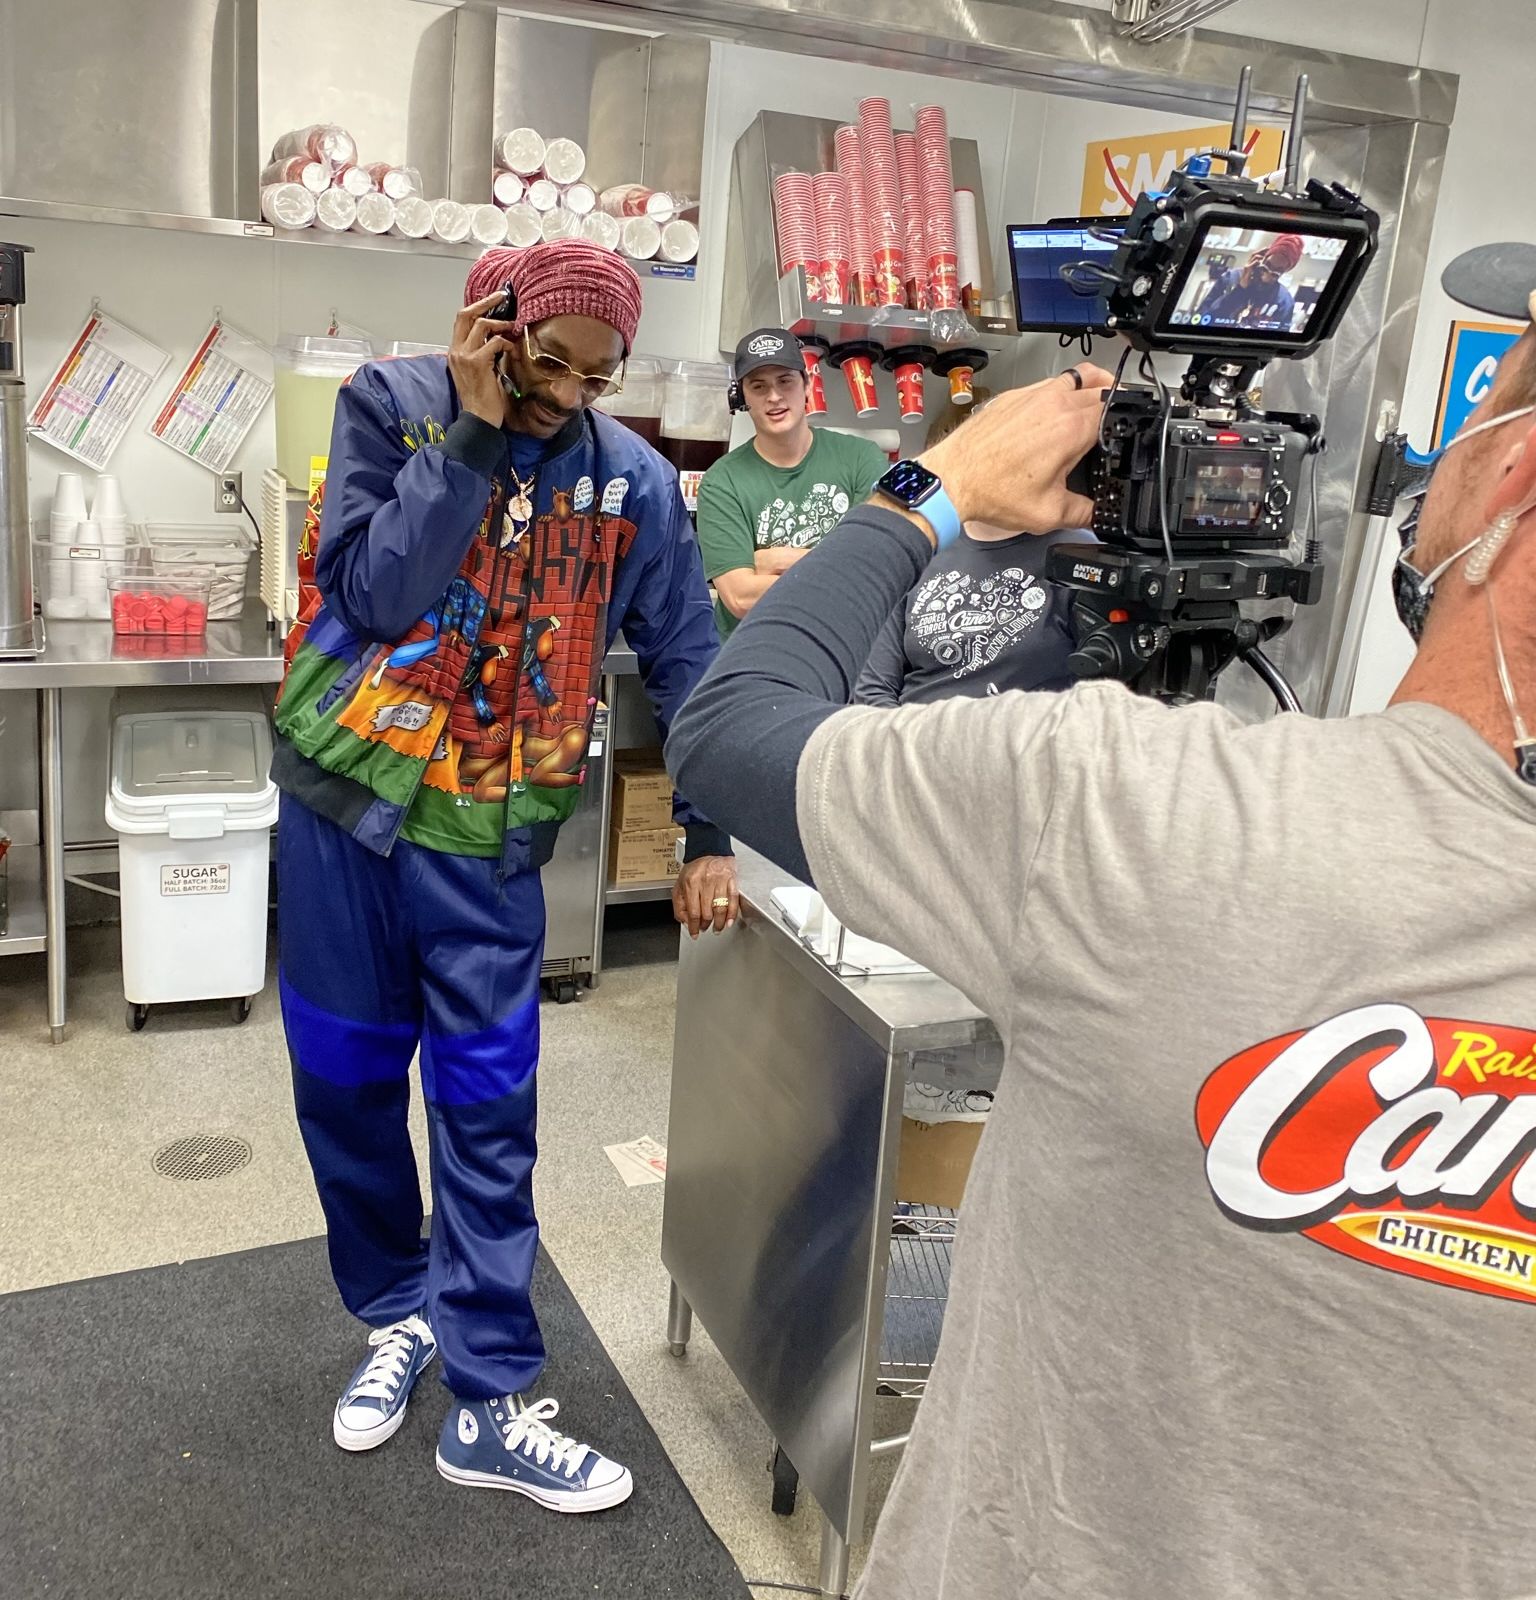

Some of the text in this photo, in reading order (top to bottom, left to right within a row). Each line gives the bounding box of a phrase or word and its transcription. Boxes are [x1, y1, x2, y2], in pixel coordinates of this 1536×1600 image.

[1002, 610, 1040, 637] LOVE
[173, 867, 218, 879] SUGAR
[1376, 1217, 1532, 1277] CHICKEN
